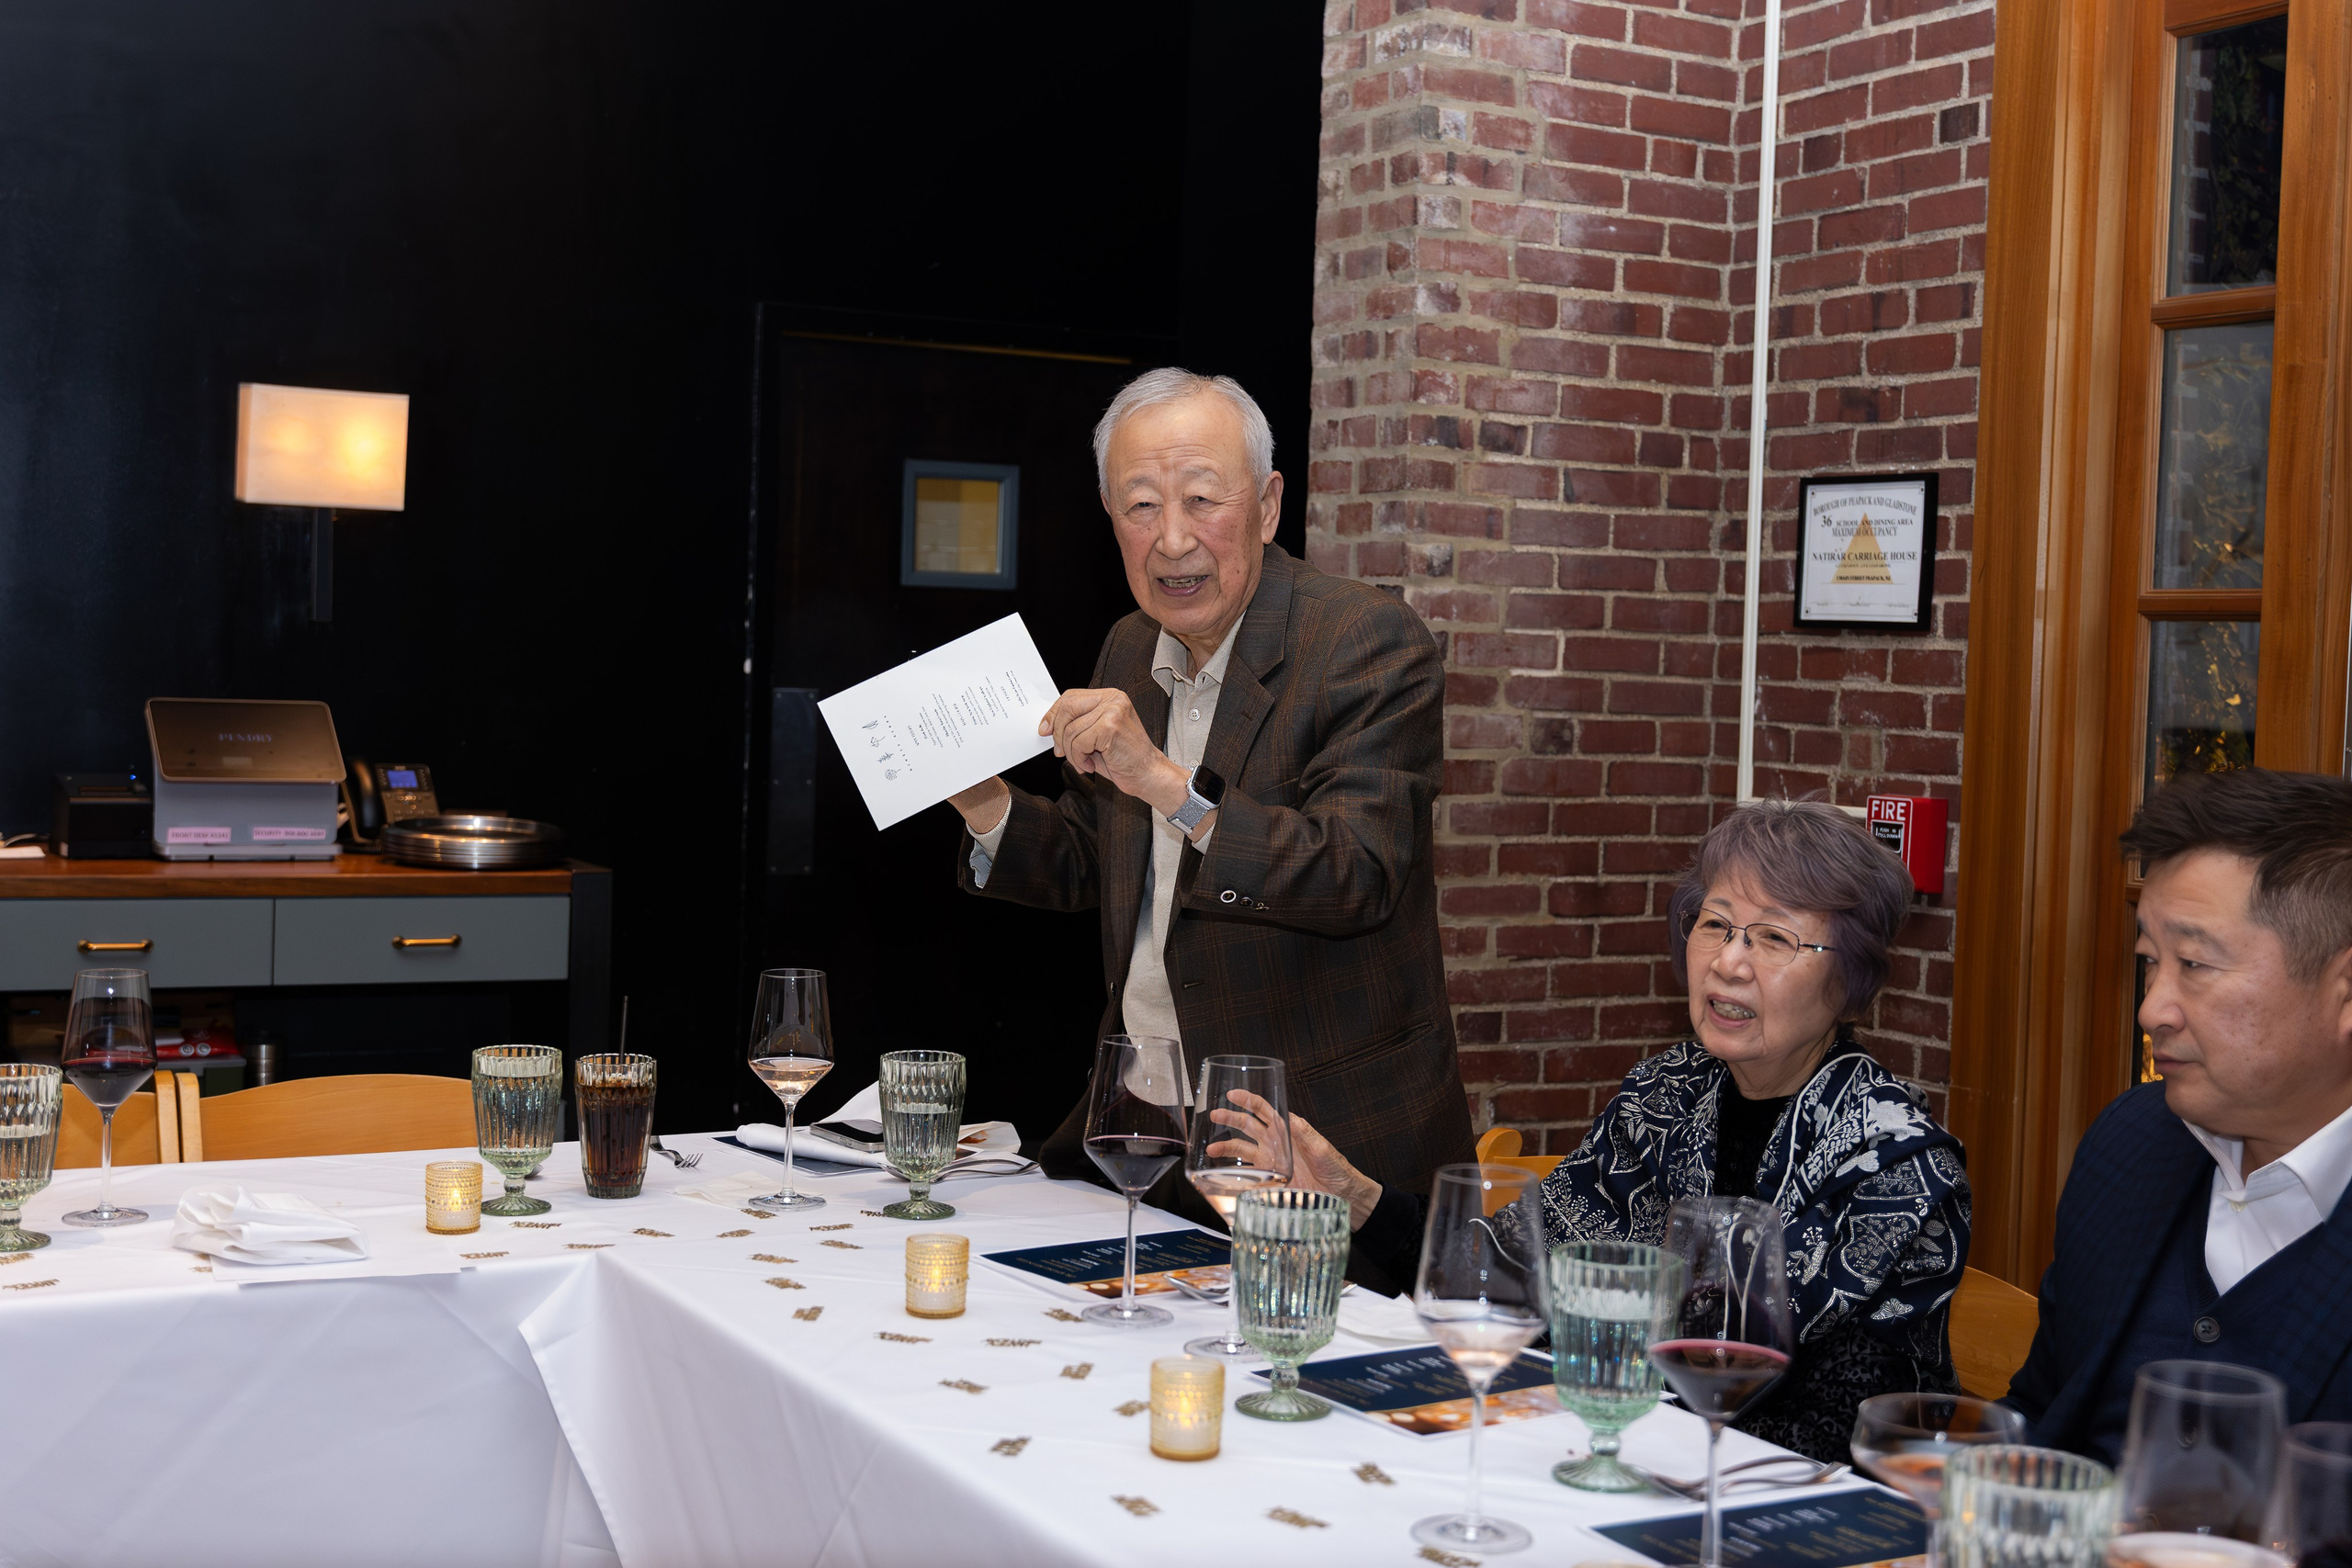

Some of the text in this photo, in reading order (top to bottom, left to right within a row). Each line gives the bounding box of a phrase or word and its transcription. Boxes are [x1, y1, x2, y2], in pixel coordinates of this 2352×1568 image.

[1814, 496, 1917, 516] BOROUGH OF PEAPACK AND GLADSTONE
[1821, 514, 1832, 527] 36
[1832, 526, 1897, 536] MAXIMUM OCCUPANCY
[1812, 551, 1917, 561] NATIRAR CARRIAGE HOUSE
[1871, 800, 1906, 821] FIRE
